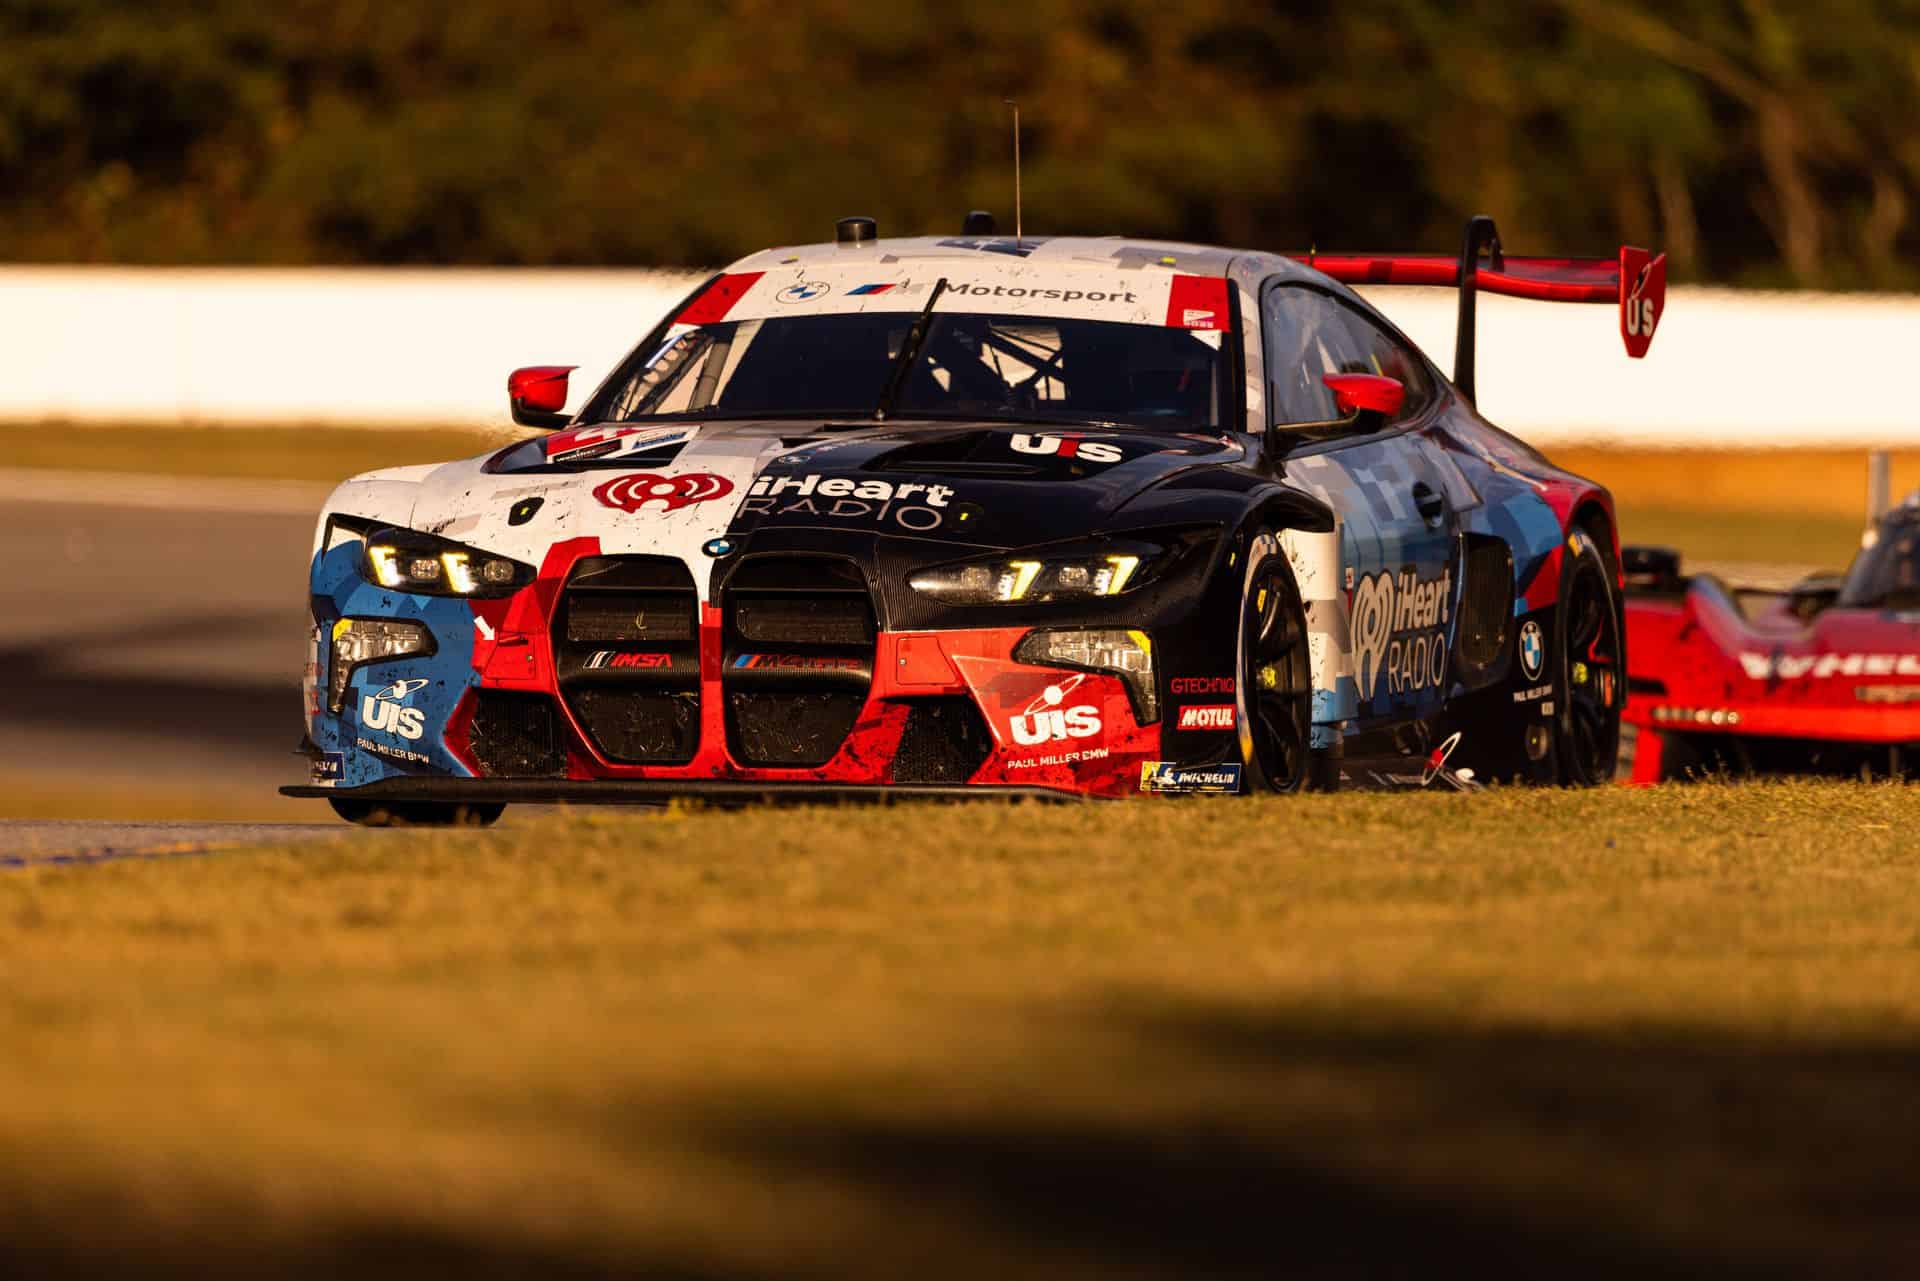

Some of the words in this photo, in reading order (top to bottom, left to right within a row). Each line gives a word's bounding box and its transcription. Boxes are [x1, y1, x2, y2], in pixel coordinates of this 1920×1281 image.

[943, 281, 1137, 303] Motorsport
[749, 474, 956, 507] iHeart
[736, 498, 943, 531] RADIO
[1394, 568, 1449, 632] iHeart
[610, 653, 673, 668] IMSA
[1388, 632, 1446, 694] RADIO
[1181, 708, 1234, 728] MOTUL
[1007, 757, 1037, 770] PAUL
[1039, 751, 1080, 767] MILLER
